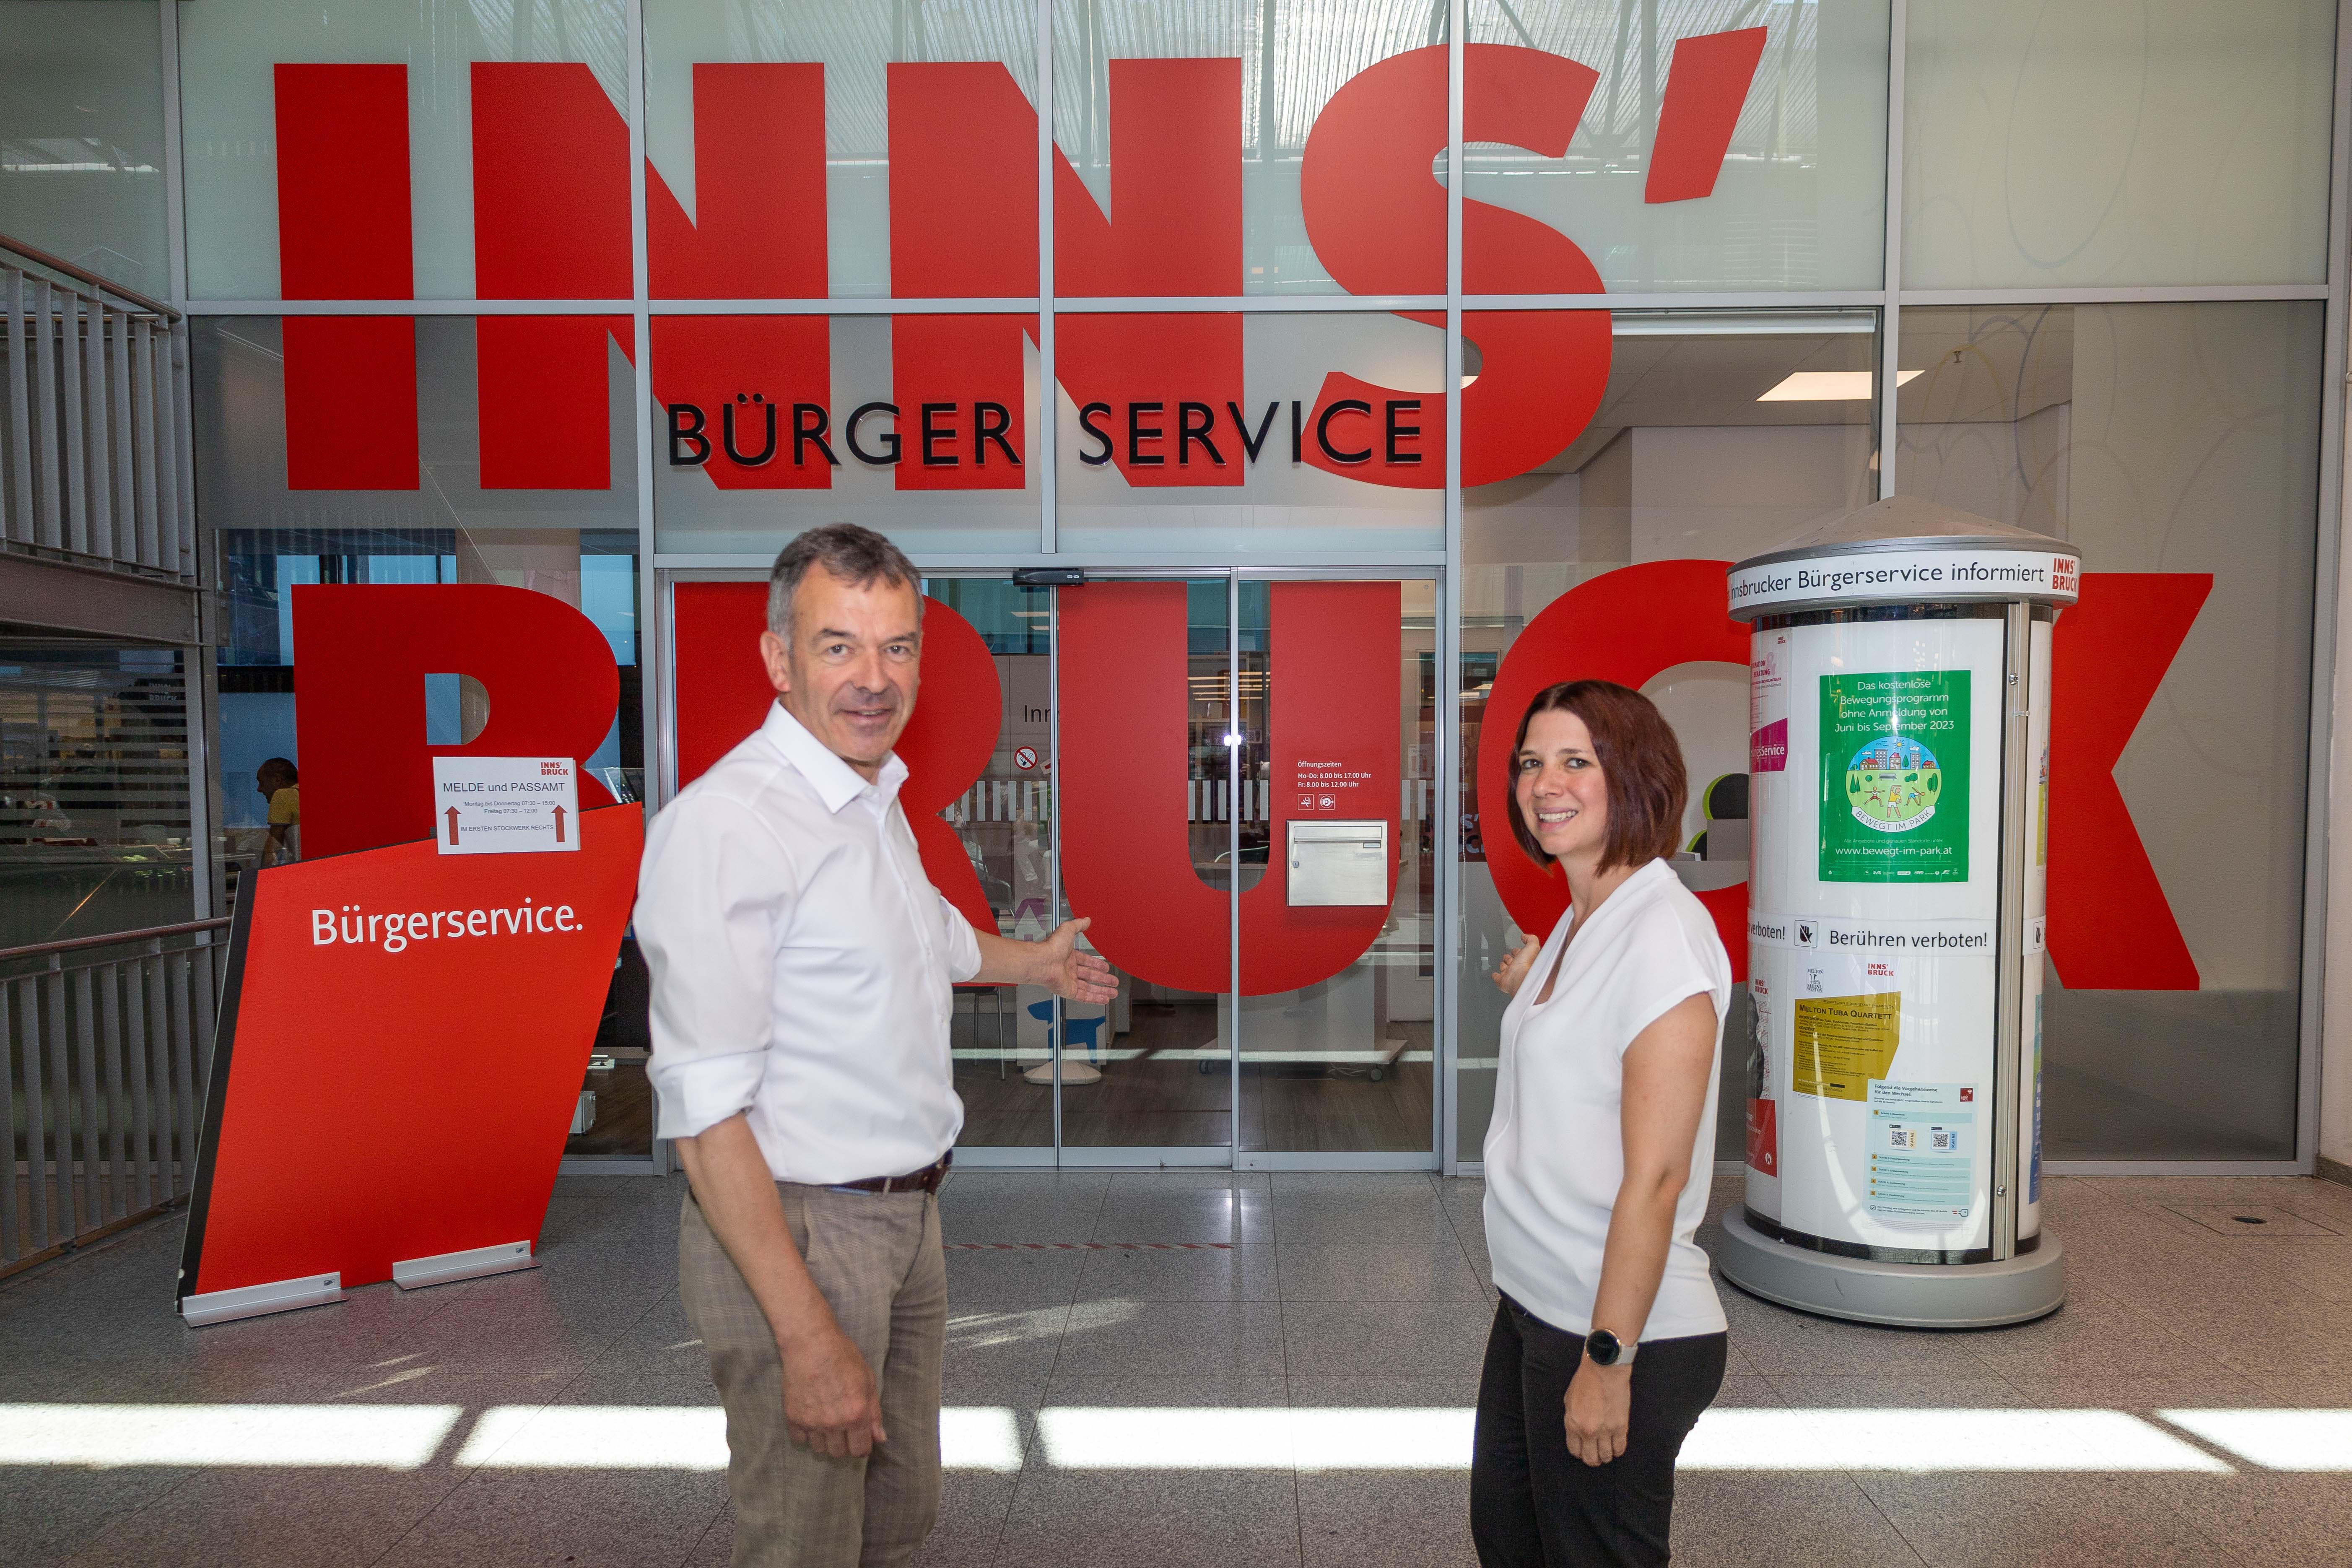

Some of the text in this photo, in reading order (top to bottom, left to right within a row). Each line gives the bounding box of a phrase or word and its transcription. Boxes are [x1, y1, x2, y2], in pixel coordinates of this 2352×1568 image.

[274, 26, 1768, 490] INNS'
[668, 393, 1422, 466] BÜRGER SERVICE
[2053, 558, 2076, 574] INNS'
[1730, 574, 1792, 600] Innsbrucker
[1799, 564, 1943, 591] Bürgerservice
[1951, 562, 2044, 583] informiert
[2052, 575, 2077, 592] BRUCK
[1857, 679, 1931, 691] Das kostenlose
[1840, 693, 1949, 705] Bewegungsprogramm
[1841, 709, 1866, 718] ohne
[1868, 708, 1926, 719] Anmeldung
[1834, 723, 1854, 732] Juni
[1857, 722, 1870, 732] bis
[1929, 720, 1954, 730] 2023
[1298, 760, 1342, 768] Öffnungszeiten
[443, 782, 565, 792] MELDE und PASSAMT
[1855, 810, 1892, 830] BEWEGT
[1909, 810, 1931, 827] PARK
[1835, 846, 1952, 857] www.bewegt-im-park.at
[312, 897, 583, 953] Bürgerservice.
[1750, 921, 1785, 940] verboten!
[1830, 930, 1987, 948] Berühren verboten!
[1755, 985, 1768, 995] BRUCK
[1799, 1004, 1892, 1020] MELTON TUBA QUARTETT
